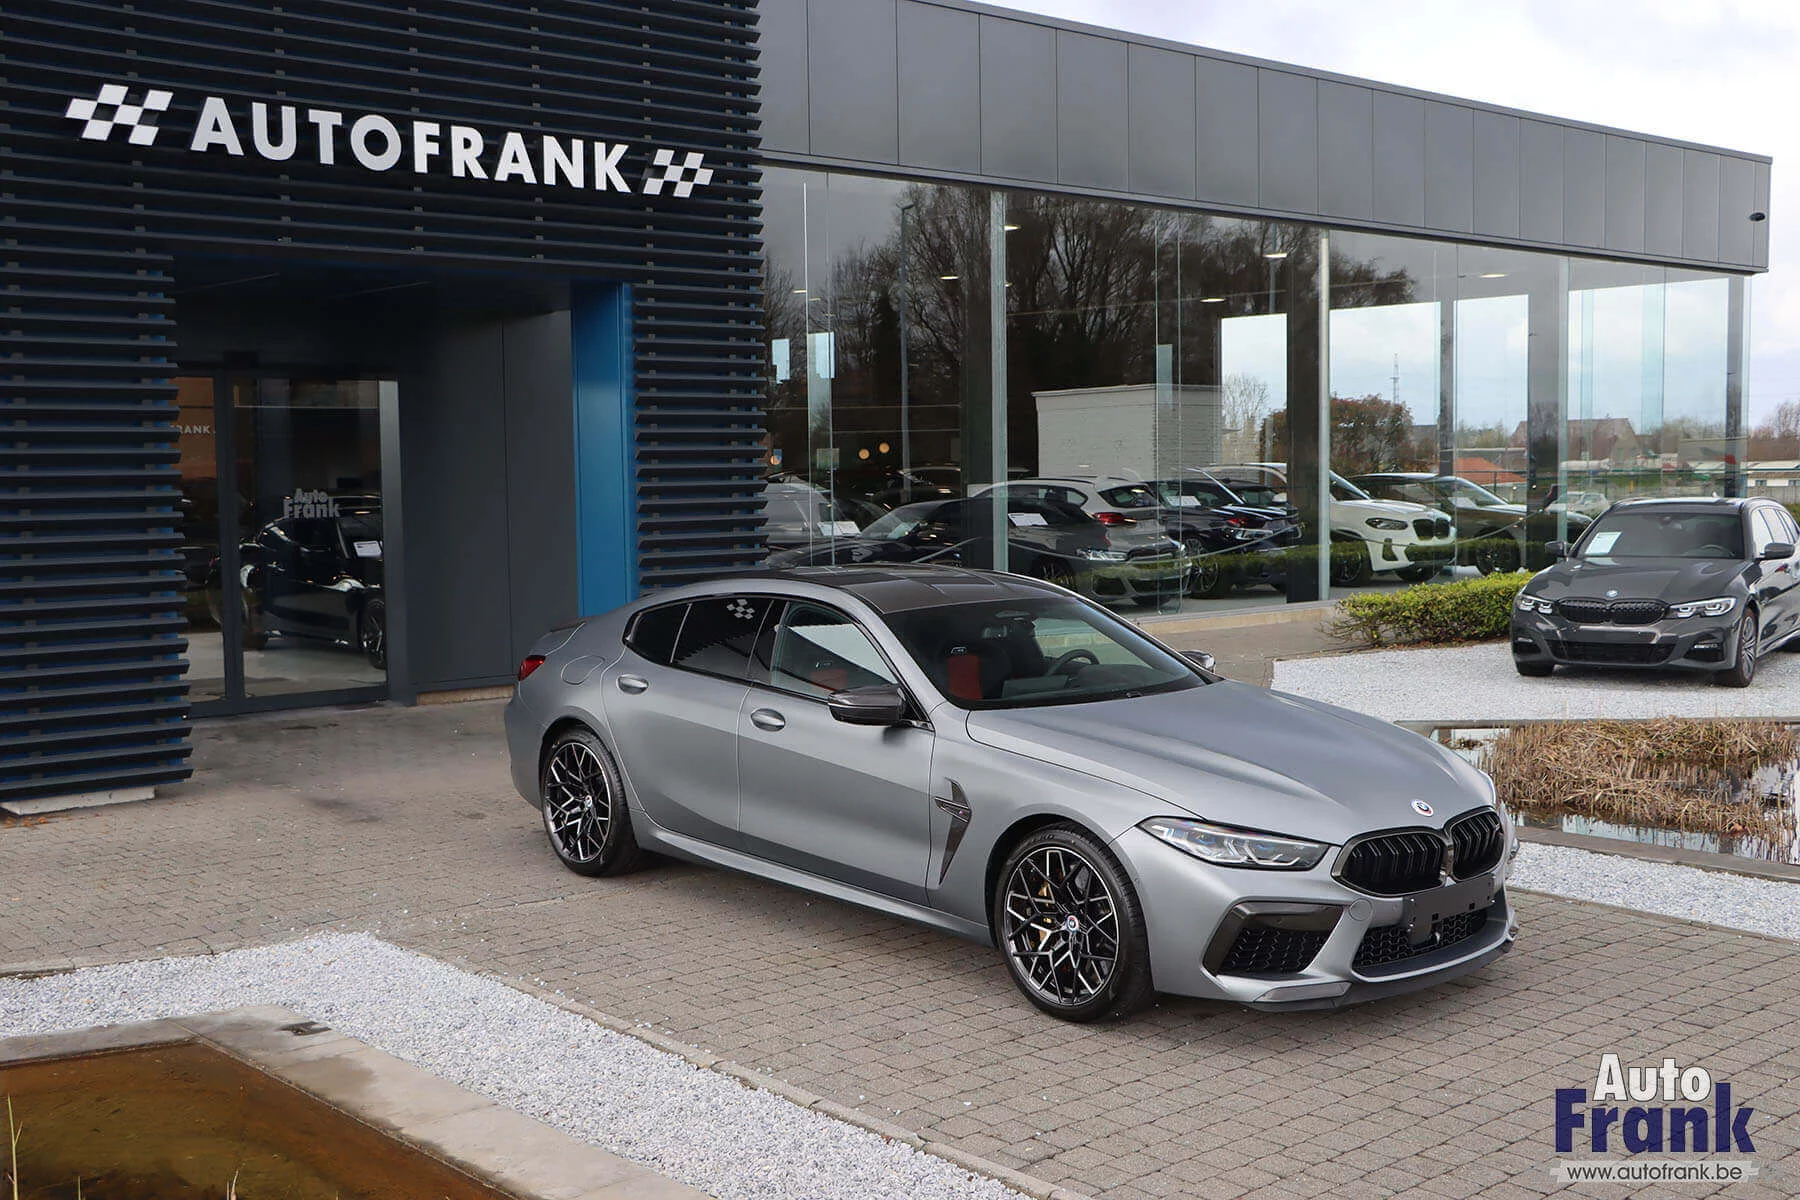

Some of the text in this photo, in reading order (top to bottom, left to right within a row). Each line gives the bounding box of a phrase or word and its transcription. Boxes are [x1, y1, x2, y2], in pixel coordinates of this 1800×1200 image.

[191, 97, 632, 193] AUTOFRANK
[294, 488, 329, 503] Auto
[283, 497, 340, 519] Frank
